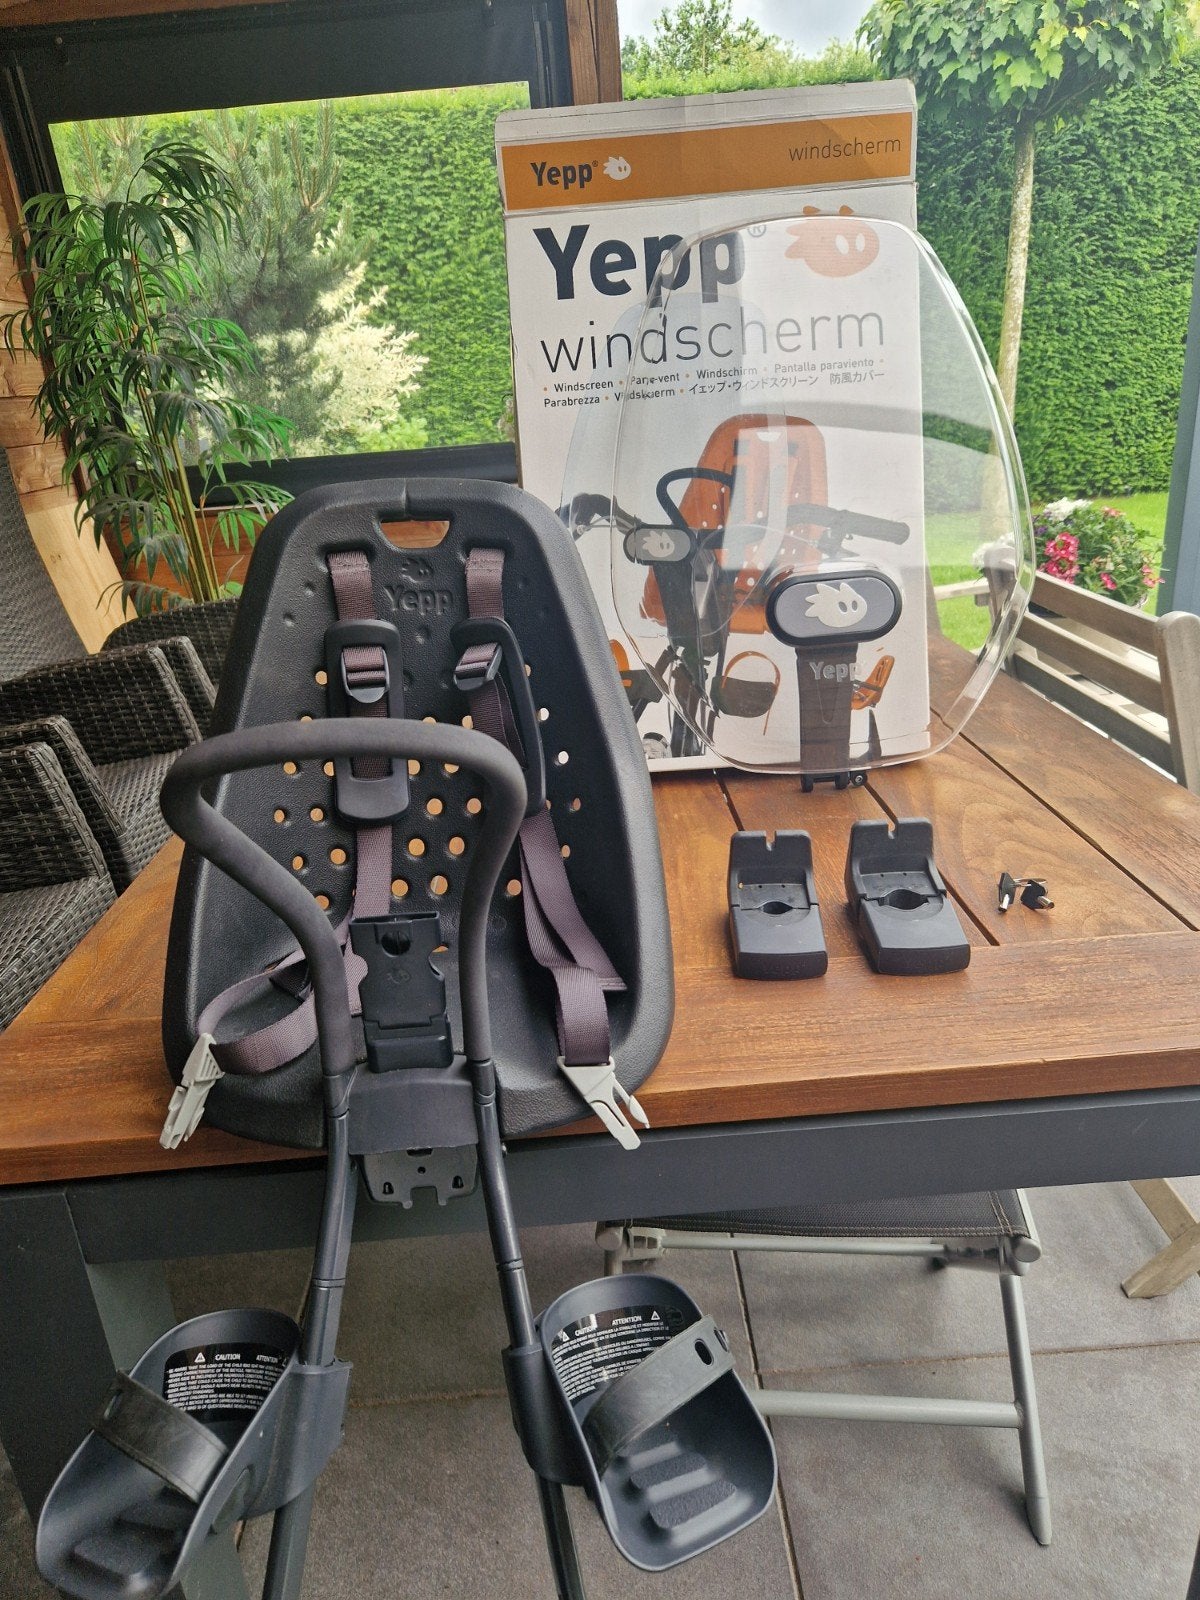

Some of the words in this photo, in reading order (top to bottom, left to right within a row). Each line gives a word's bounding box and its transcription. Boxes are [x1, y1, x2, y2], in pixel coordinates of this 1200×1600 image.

[788, 137, 902, 162] windscherm
[540, 306, 884, 373] windscherm
[554, 379, 614, 393] Windscreen
[696, 366, 758, 380] Windschirm
[774, 361, 817, 374] Pantalla
[820, 358, 875, 373] paraviento
[544, 395, 600, 408] Parabrezza
[383, 585, 454, 616] Yepp
[215, 1353, 241, 1362] CAUTION
